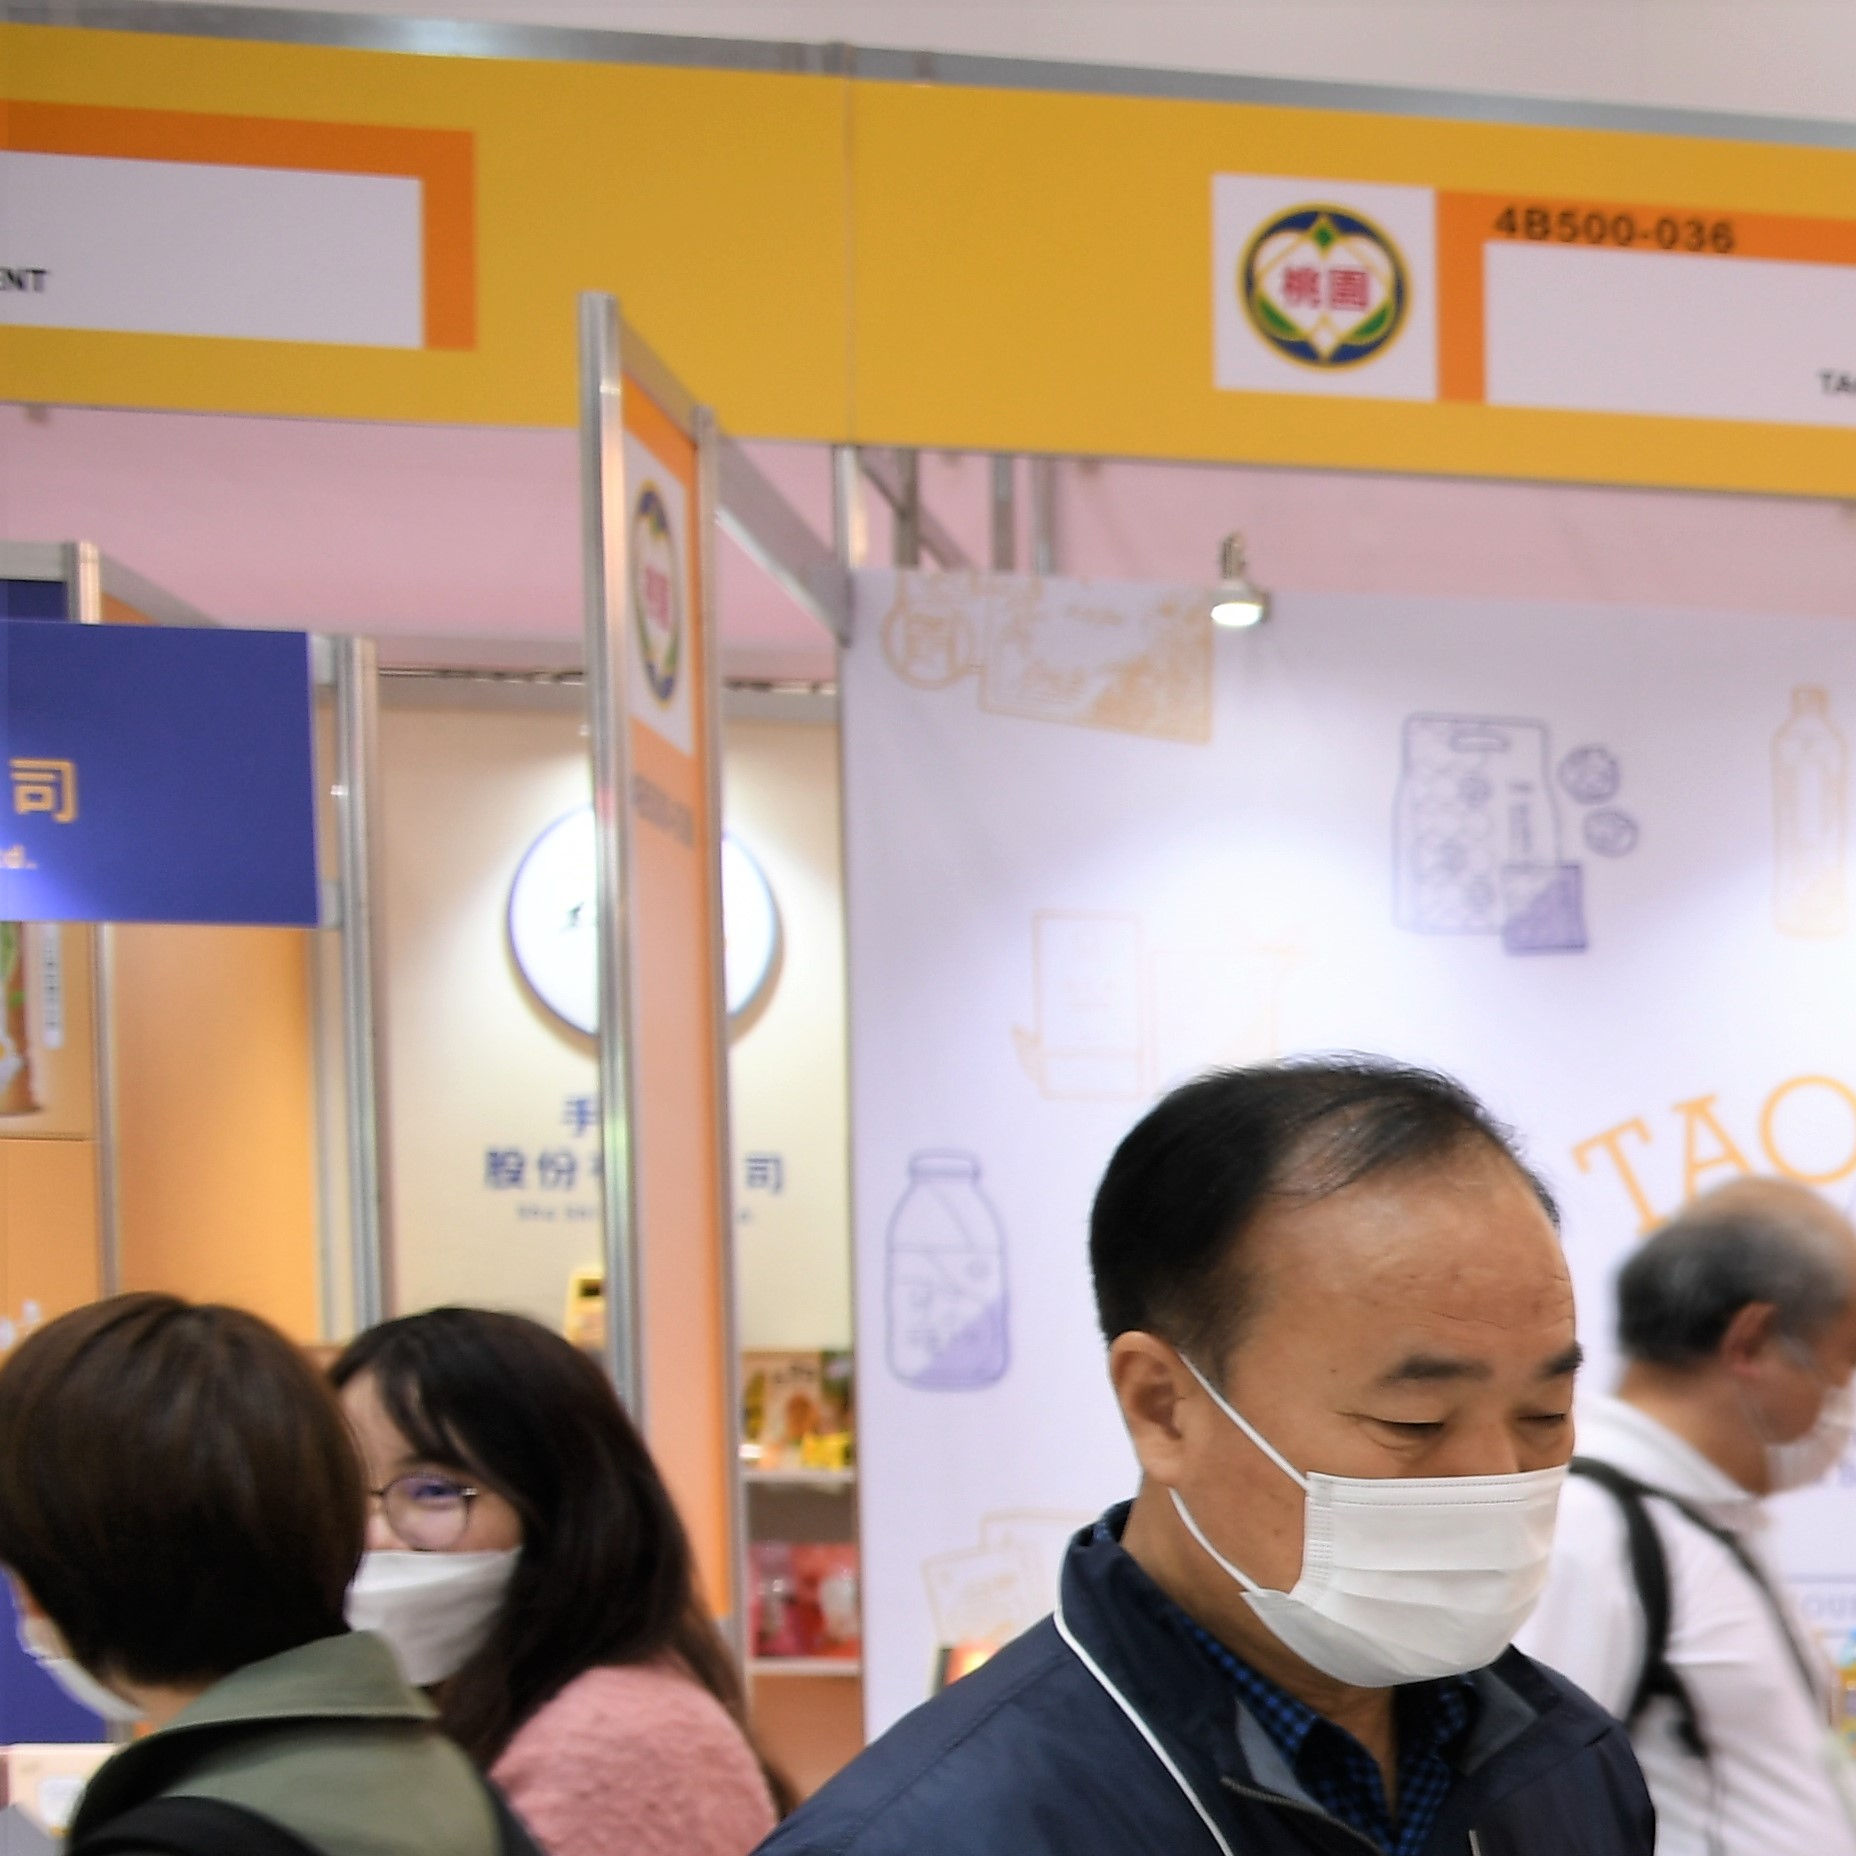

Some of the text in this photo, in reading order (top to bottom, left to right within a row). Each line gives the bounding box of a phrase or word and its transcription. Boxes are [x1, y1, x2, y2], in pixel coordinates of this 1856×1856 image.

[1494, 206, 1736, 254] 4B500-036
[0, 267, 49, 292] NT
[1282, 265, 1370, 311] 桃園
